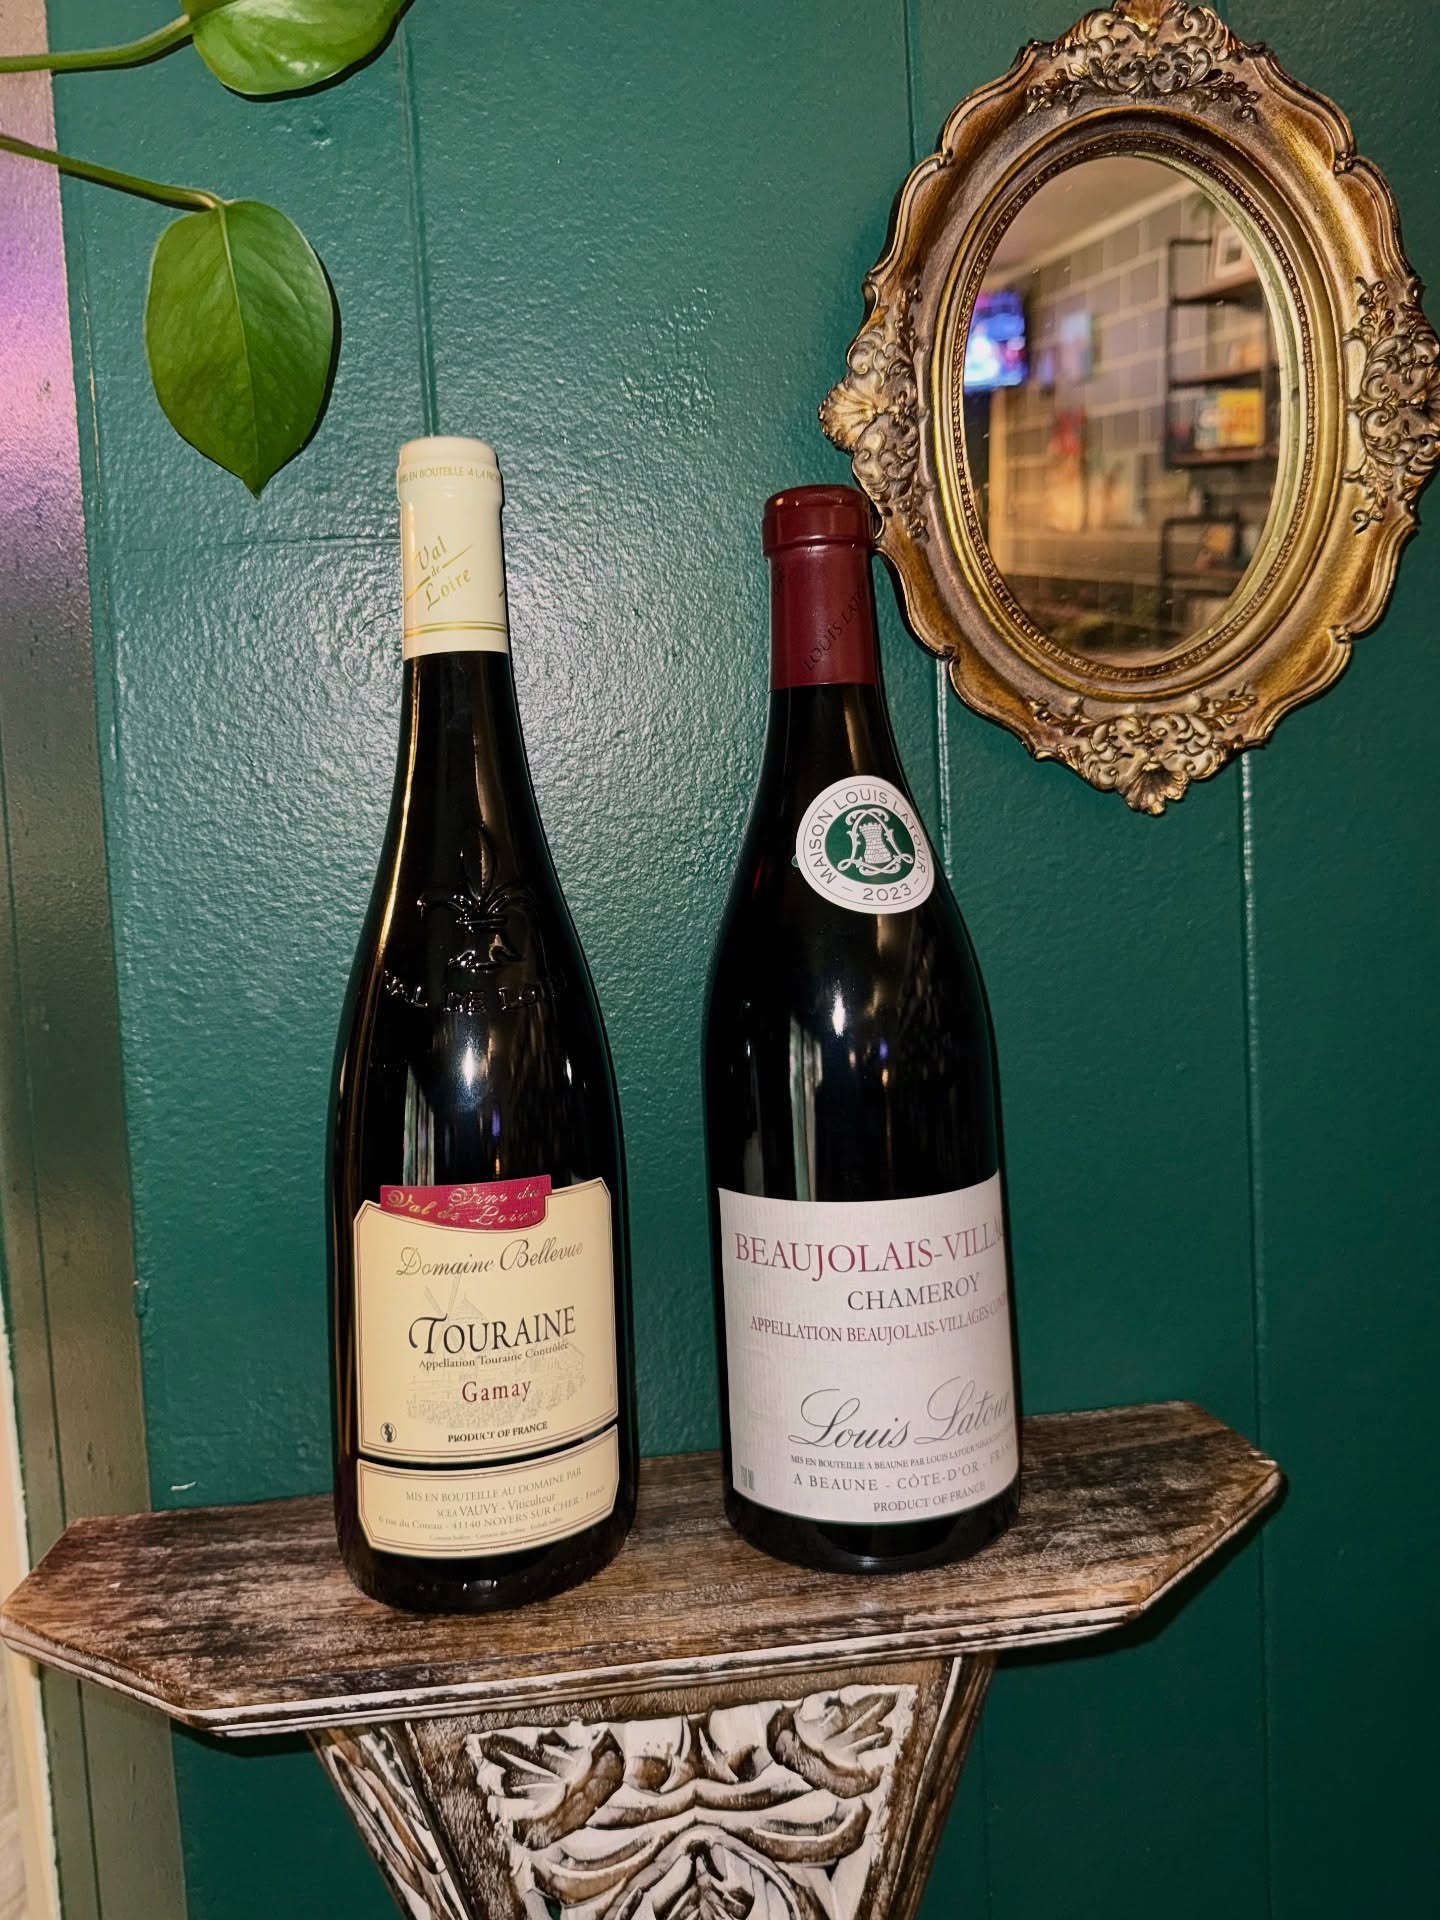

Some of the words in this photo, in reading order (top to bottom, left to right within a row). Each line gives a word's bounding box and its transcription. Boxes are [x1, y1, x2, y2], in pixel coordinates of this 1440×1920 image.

[416, 535, 448, 573] Val
[430, 565, 441, 578] de
[424, 568, 473, 611] Loire
[803, 620, 843, 672] LOUIS
[808, 808, 837, 885] MAISON
[833, 788, 889, 811] LOUIS
[892, 800, 926, 875] LATOUR
[863, 883, 912, 901] 2023
[386, 1189, 438, 1215] Val
[396, 1246, 494, 1277] Domaine
[500, 1236, 584, 1272] Bellevue
[847, 1271, 980, 1311] CHAMEROY
[408, 1305, 576, 1354] TOURAINE
[750, 1315, 842, 1343] APPELLATION
[846, 1306, 989, 1346] BEAUJOLAIS-VILLAGES
[418, 1356, 475, 1372] Appellation
[478, 1352, 522, 1366] Touraine
[462, 1380, 532, 1403] Gamay
[447, 1431, 495, 1443] PRODUCT
[497, 1428, 511, 1438] OF
[512, 1421, 549, 1436] FRANCE
[788, 1388, 911, 1448] Louis
[791, 1454, 803, 1464] MIS
[805, 1457, 816, 1466] EN
[818, 1459, 865, 1470] BOUTEILLE
[874, 1458, 909, 1470] BEAUNE
[910, 1456, 925, 1467] PAR
[926, 1453, 948, 1465] LOUIS
[406, 1491, 423, 1501] MIS
[425, 1491, 439, 1501] EN
[441, 1488, 499, 1502] BOUTEILLE
[502, 1486, 517, 1497] AU
[518, 1475, 565, 1494] DOMAINE
[566, 1467, 582, 1480] PAR
[794, 1473, 803, 1486] A
[809, 1475, 878, 1491] BEAUNE
[873, 1496, 931, 1513] PRODUCT
[932, 1493, 949, 1506] OF
[950, 1480, 986, 1501] FRANCE
[460, 1502, 498, 1517] VAUVY
[508, 1492, 556, 1511] Viticulteur
[484, 1512, 528, 1527] NOYERS
[530, 1506, 552, 1519] SUR
[552, 1496, 580, 1512] CHER
